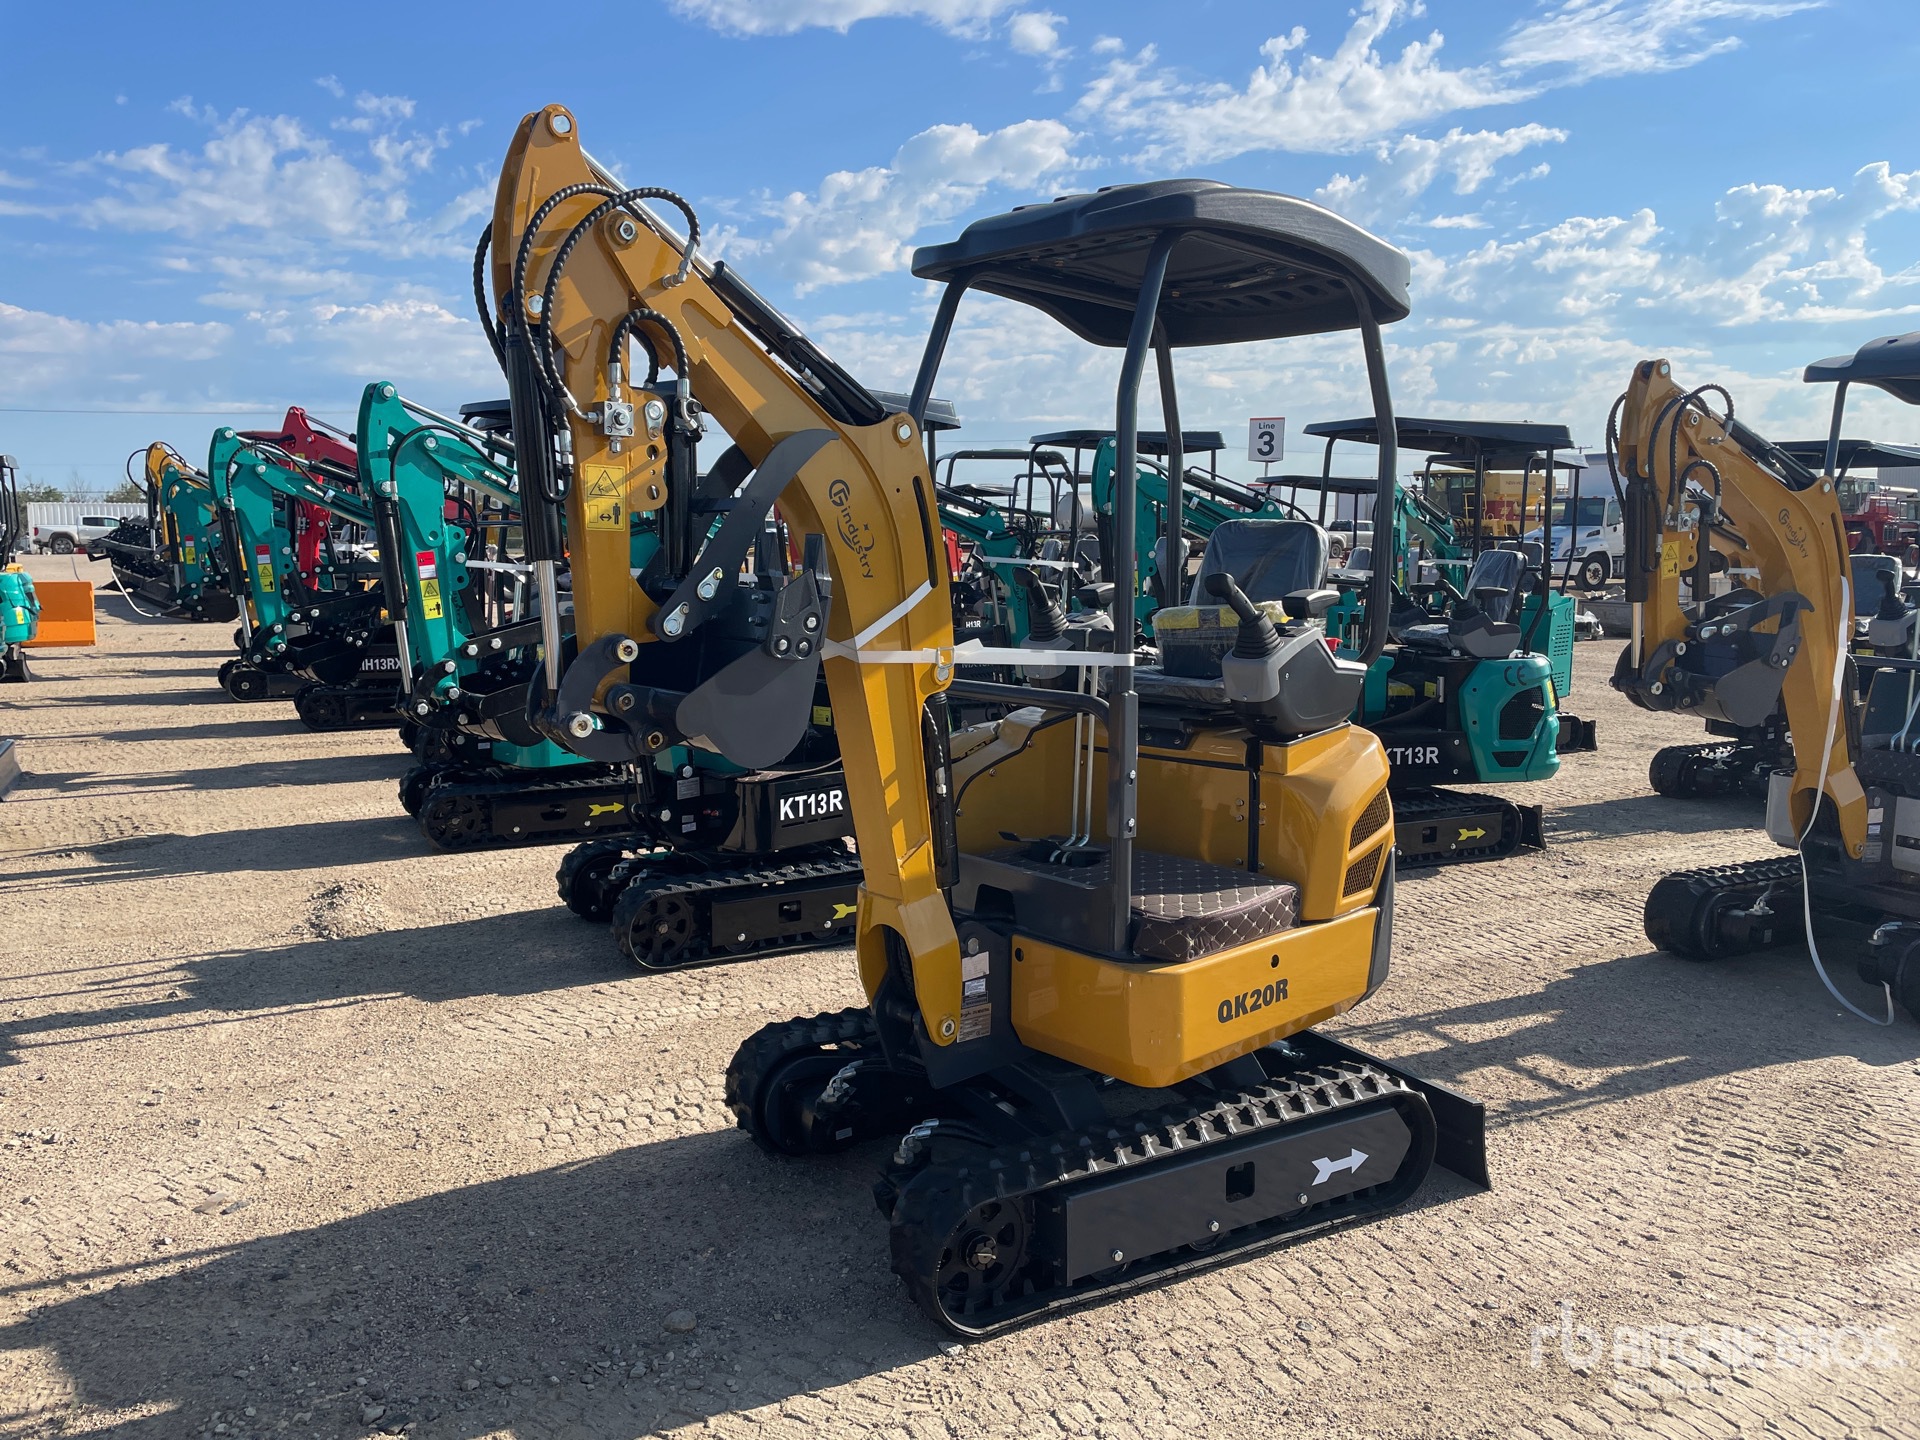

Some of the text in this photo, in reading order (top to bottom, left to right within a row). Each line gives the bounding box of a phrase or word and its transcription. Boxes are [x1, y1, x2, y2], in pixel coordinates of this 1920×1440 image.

[1258, 422, 1276, 430] Line
[1256, 430, 1275, 457] 3
[780, 789, 844, 821] KT13R
[1217, 978, 1289, 1024] QK20R
